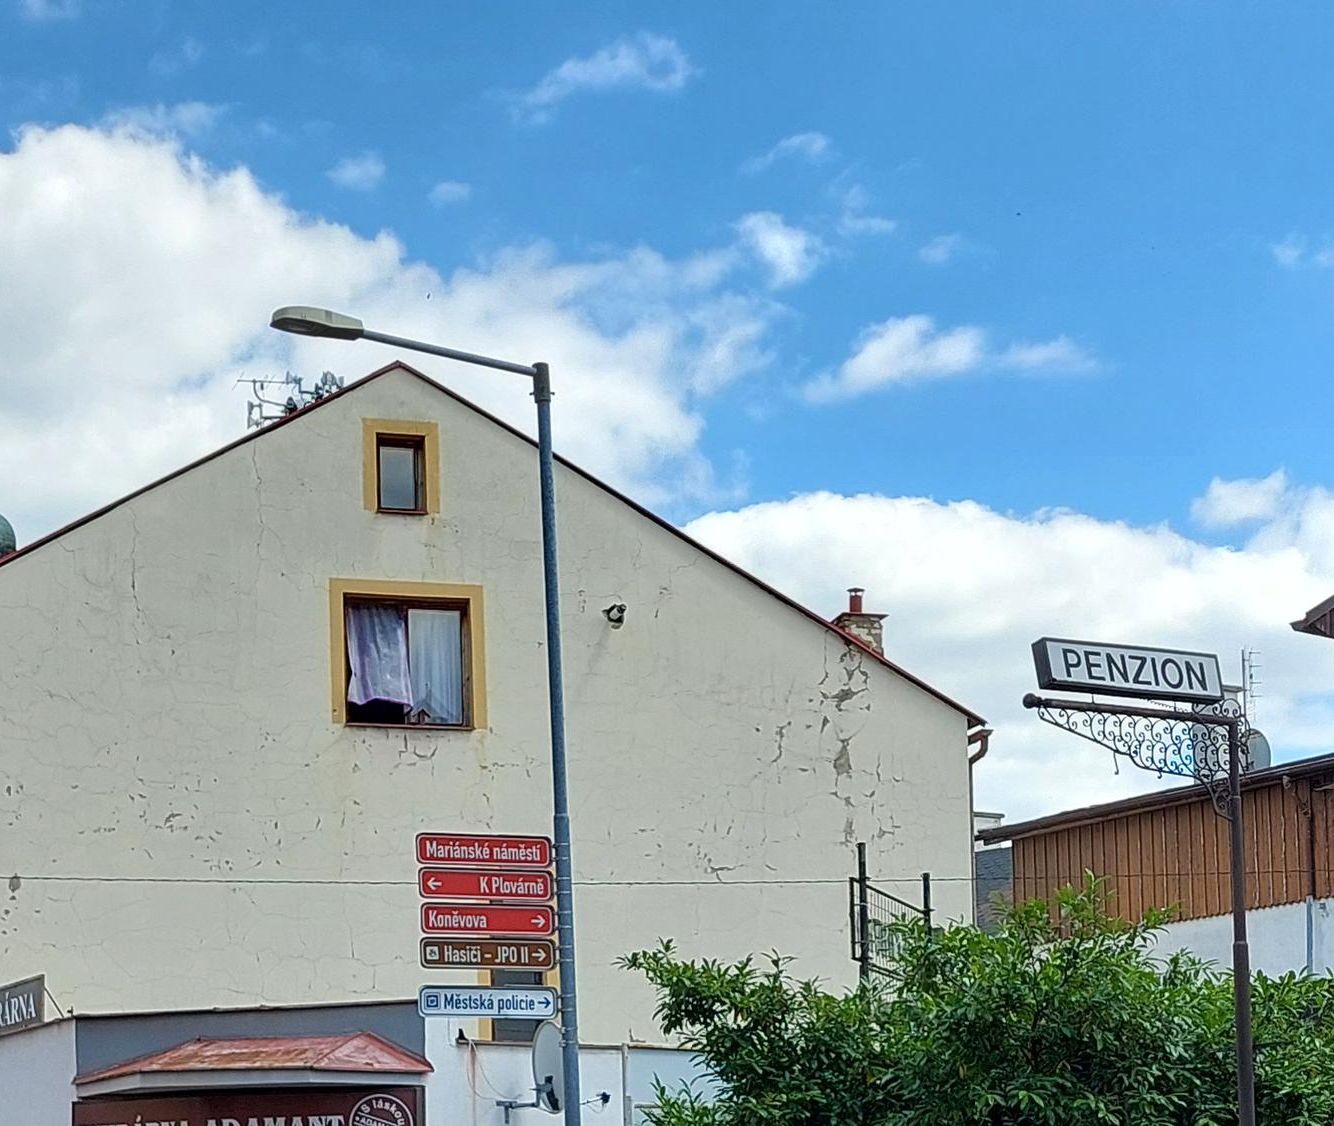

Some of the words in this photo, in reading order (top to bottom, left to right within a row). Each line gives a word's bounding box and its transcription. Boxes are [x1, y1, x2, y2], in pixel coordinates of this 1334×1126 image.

[1061, 647, 1209, 691] PENZION
[425, 840, 490, 860] Mariánské
[493, 844, 541, 862] náměstí
[480, 876, 489, 892] K
[492, 877, 544, 895] Plovárně
[428, 910, 487, 928] Koněvova
[444, 945, 481, 964] Hasiči
[494, 946, 517, 963] JPO
[520, 947, 529, 963] II
[443, 994, 494, 1011] Městská
[497, 996, 535, 1014] policie
